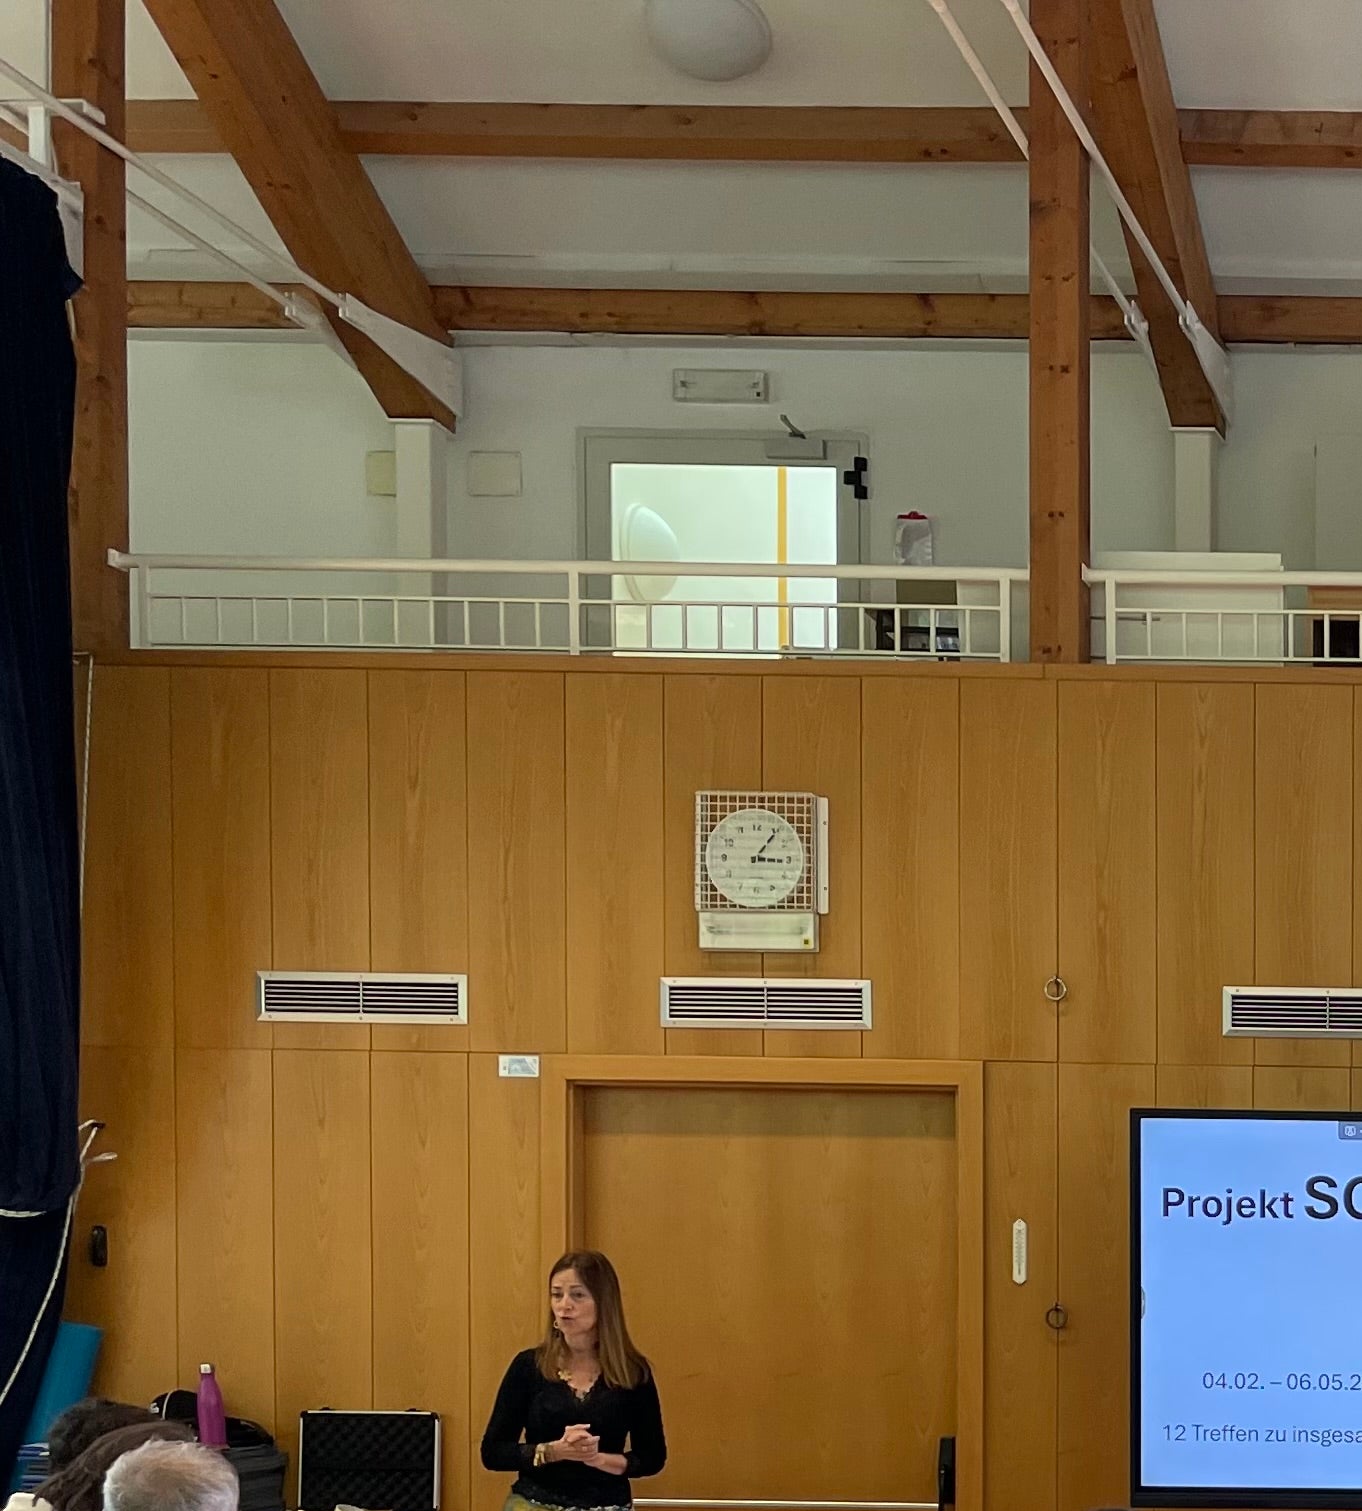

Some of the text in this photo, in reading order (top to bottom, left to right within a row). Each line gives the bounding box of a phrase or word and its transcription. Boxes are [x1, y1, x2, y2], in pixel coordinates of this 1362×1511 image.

[785, 855, 792, 864] 3
[1162, 1187, 1294, 1226] Projekt
[1202, 1372, 1265, 1391] 04.02.
[1162, 1424, 1187, 1442] 12
[1191, 1424, 1259, 1443] Treffen
[1264, 1428, 1287, 1443] zu
